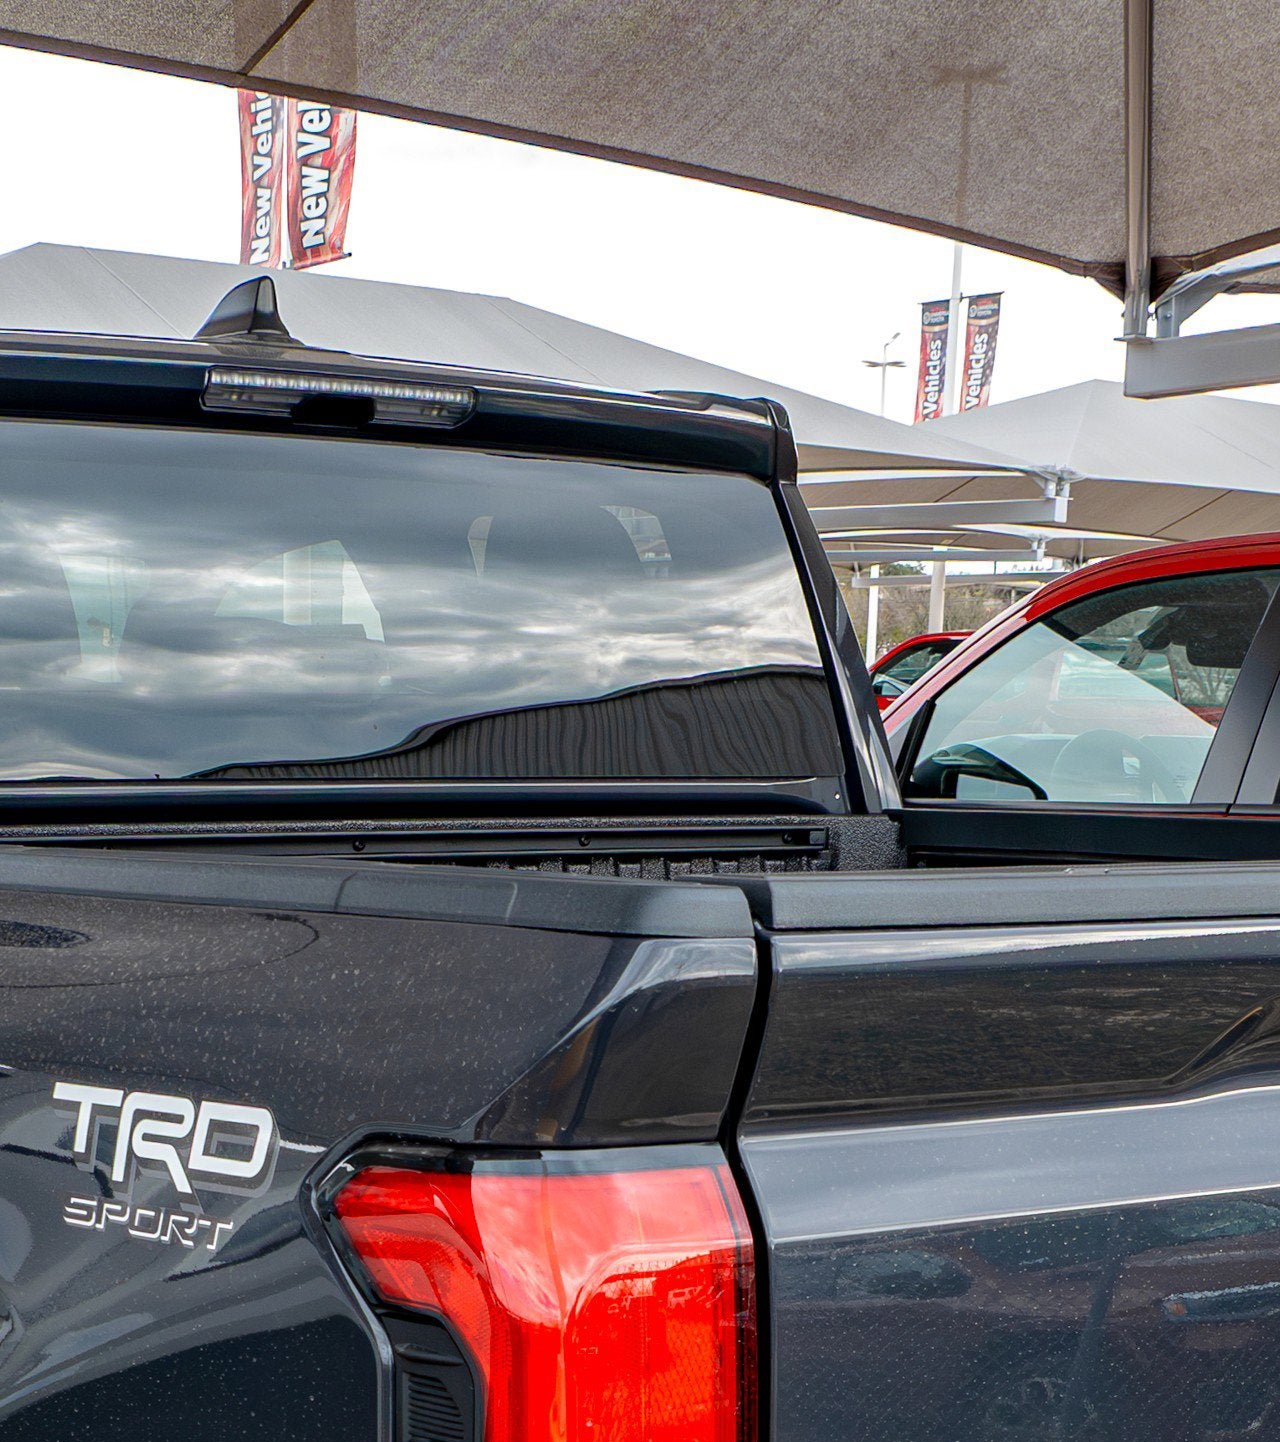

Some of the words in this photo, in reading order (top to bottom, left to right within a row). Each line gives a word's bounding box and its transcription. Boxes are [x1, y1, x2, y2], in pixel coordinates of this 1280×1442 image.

[249, 187, 271, 266] New
[300, 165, 330, 249] New
[923, 338, 942, 416] Vehicles
[965, 332, 989, 410] Vehicles
[52, 1081, 277, 1195] TRD
[63, 1197, 234, 1251] SPORT
